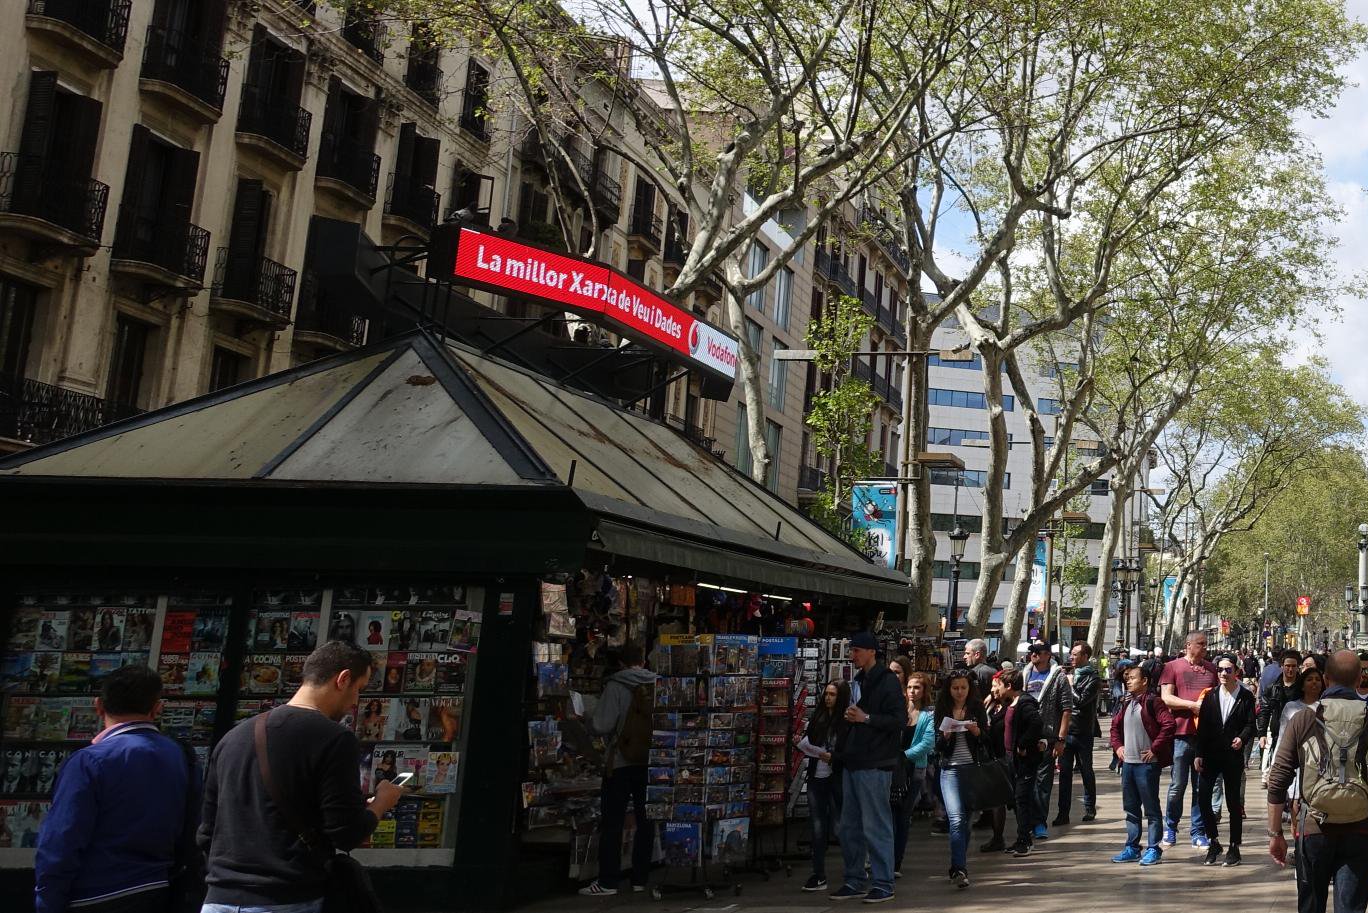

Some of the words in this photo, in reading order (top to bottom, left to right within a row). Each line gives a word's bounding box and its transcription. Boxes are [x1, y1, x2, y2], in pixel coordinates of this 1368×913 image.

[477, 244, 501, 273] La
[505, 258, 568, 289] millor
[569, 270, 618, 306] Xarxa
[618, 289, 631, 313] de
[633, 295, 650, 323] Veu
[650, 305, 655, 325] i
[655, 307, 682, 339] Dades
[707, 335, 738, 368] Vodafon
[374, 750, 404, 758] GLAUR
